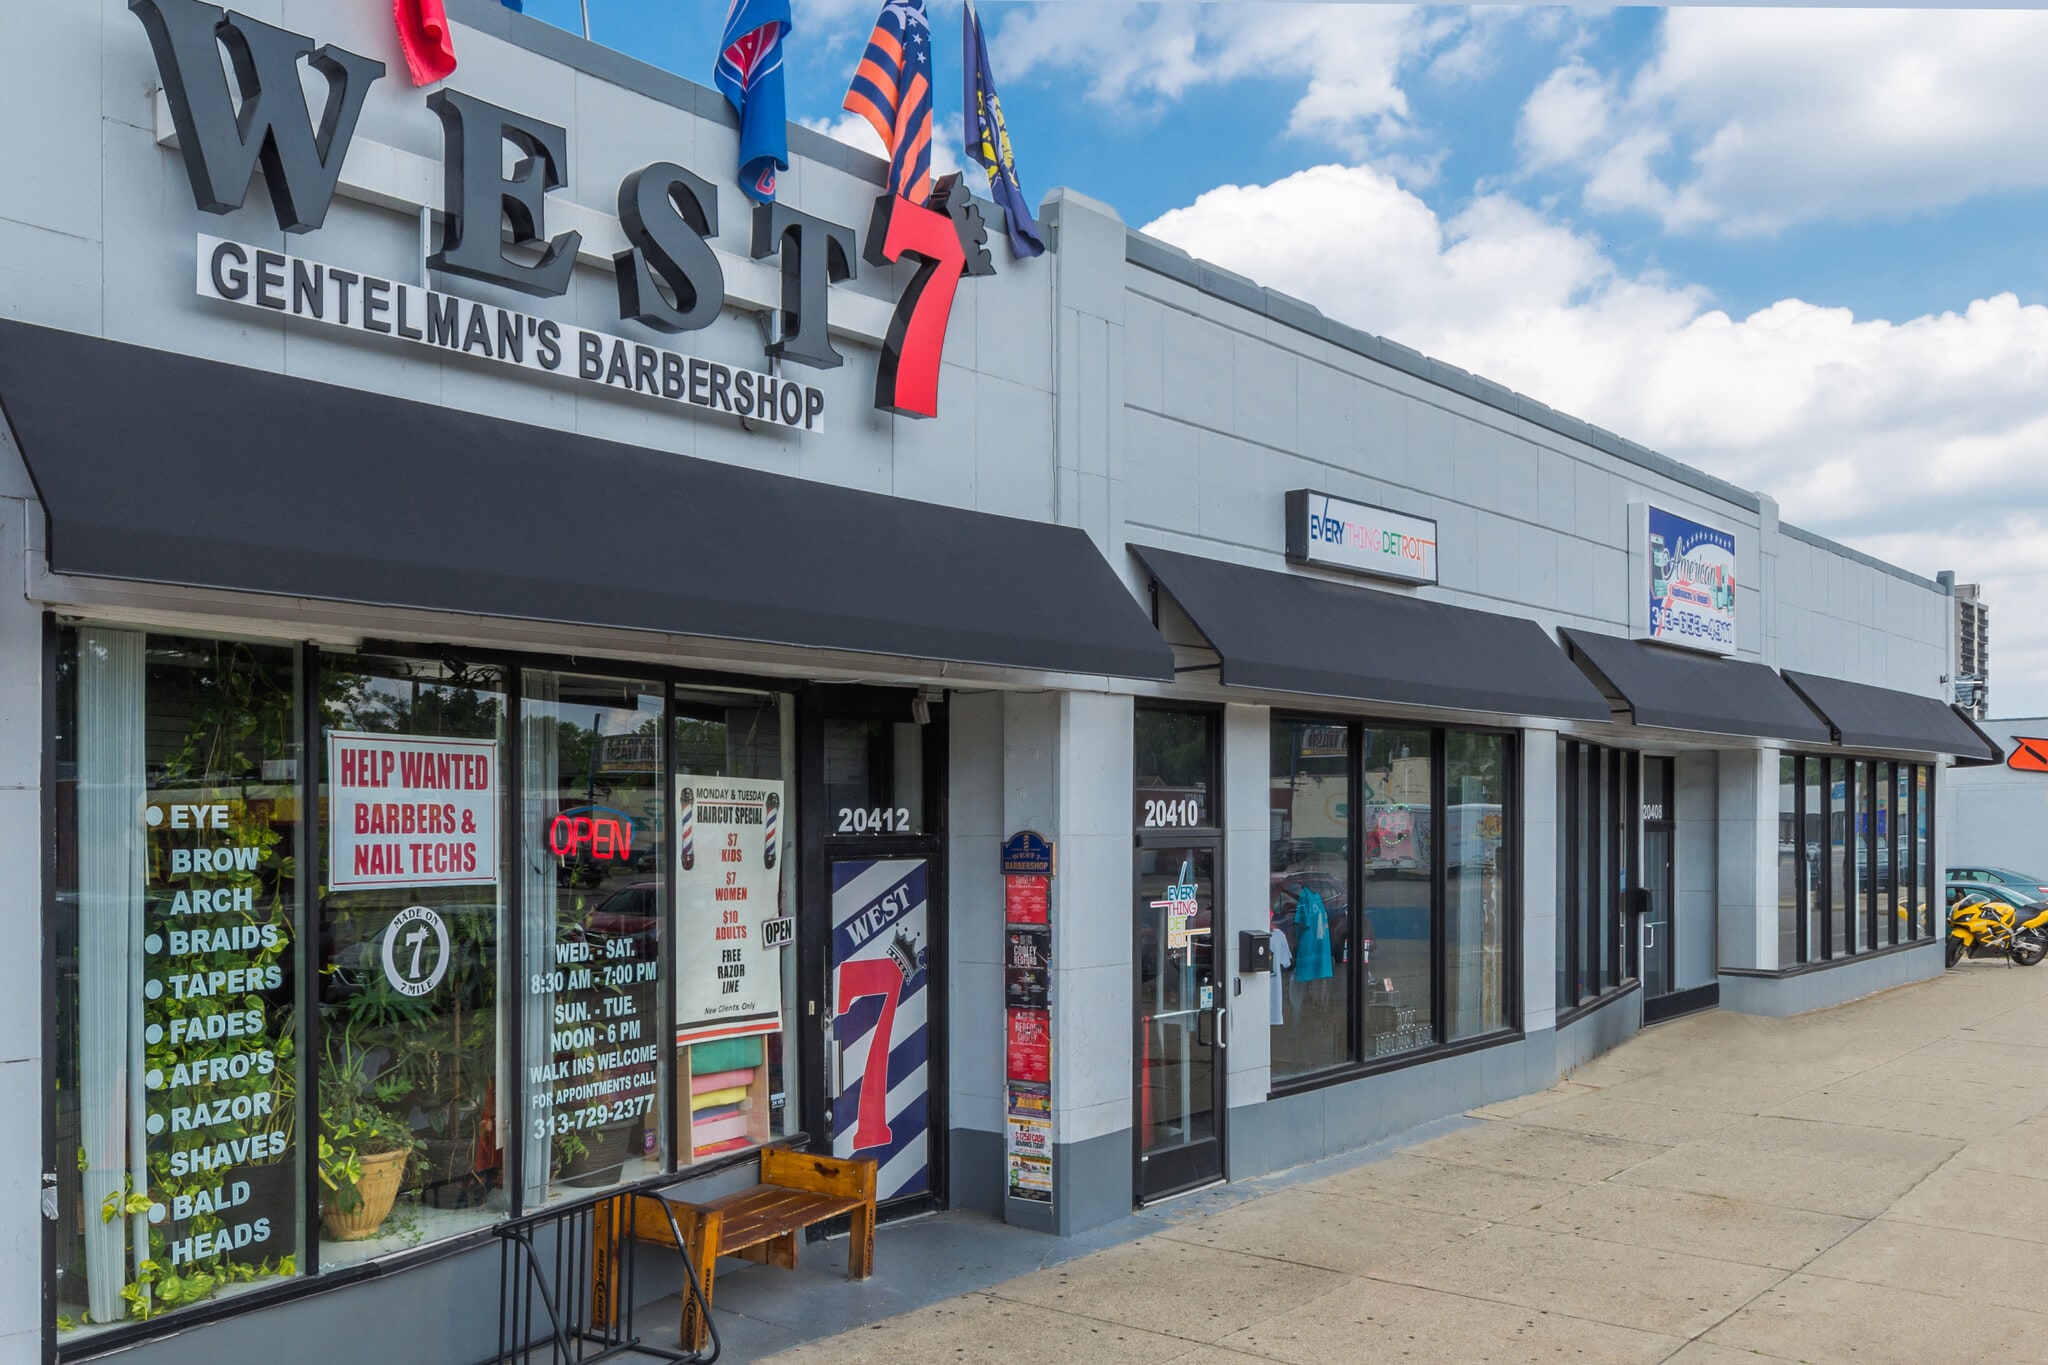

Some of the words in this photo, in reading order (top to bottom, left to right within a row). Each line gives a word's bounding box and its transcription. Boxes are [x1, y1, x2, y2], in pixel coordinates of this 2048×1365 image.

[128, 0, 857, 370] WEST
[863, 193, 966, 419] 7
[211, 241, 562, 371] GENTELMAN'S
[579, 329, 824, 430] BARBERSHOP
[1383, 530, 1437, 579] DETROIT
[1661, 536, 1717, 586] American
[340, 748, 394, 789] HELP
[400, 752, 489, 791] WANTED
[696, 787, 728, 800] MONDAY
[730, 789, 736, 799] &
[737, 789, 767, 801] TUESDAY
[171, 805, 229, 829] EYE
[354, 803, 456, 835] BARBERS
[461, 808, 476, 834] &
[696, 806, 733, 824] HAIRCUT
[735, 808, 763, 825] SPECIAL
[838, 807, 910, 832] 20412
[1144, 799, 1198, 827] 20410
[1643, 804, 1663, 820] 20408
[550, 815, 631, 861] OPEN
[727, 833, 738, 847] $7
[172, 847, 260, 874] BROW
[354, 843, 404, 876] NAIL
[410, 842, 477, 873] TECHS
[721, 849, 742, 863] KIDS
[1005, 861, 1049, 870] BARBERSHOP
[1011, 852, 1036, 860] WEST
[726, 871, 737, 885] $7
[1168, 861, 1198, 901] EVERY
[170, 887, 253, 916] ARCH
[715, 887, 748, 901] WOMEN
[1151, 900, 1198, 917] THING
[394, 908, 422, 929] MADE
[425, 911, 440, 926] ON
[723, 911, 738, 924] $10
[845, 883, 911, 947] WEST
[1168, 915, 1187, 931] DET
[169, 925, 279, 956] BRAIDS
[715, 925, 747, 941] ADULTS
[766, 919, 792, 944] OPEN
[405, 931, 425, 978] 7
[555, 942, 593, 965] WED.
[606, 938, 635, 960] SAT.
[722, 949, 742, 963] FREE
[169, 966, 282, 998] TAPERS
[531, 972, 564, 995] 8:30
[568, 969, 590, 990] AM
[604, 964, 633, 986] 7:00
[637, 961, 657, 982] PM
[717, 964, 745, 979] RAZOR
[722, 980, 739, 995] LINE
[555, 1000, 591, 1025] SUN.
[604, 995, 637, 1018] TUE.
[704, 1007, 717, 1015] New
[718, 1003, 740, 1014] Clients
[741, 1002, 756, 1012] Only
[170, 1010, 263, 1044] FADES
[551, 1026, 595, 1052] NOON
[607, 1023, 616, 1041] 6
[620, 1020, 641, 1040] PM
[530, 1060, 569, 1084] WALK
[573, 1056, 594, 1078] INS
[598, 1045, 657, 1072] WELCOME
[838, 957, 905, 1151] 7
[171, 1051, 275, 1088] AFRO'S
[532, 1092, 553, 1110] FOR
[555, 1075, 631, 1105] APPOINTMENTS
[634, 1070, 657, 1088] CALL
[171, 1092, 273, 1133] RAZOR
[533, 1094, 655, 1140] 313-729-2377
[170, 1131, 286, 1177] SHAVES
[173, 1180, 251, 1221] BALD
[172, 1218, 272, 1266] HEADS
